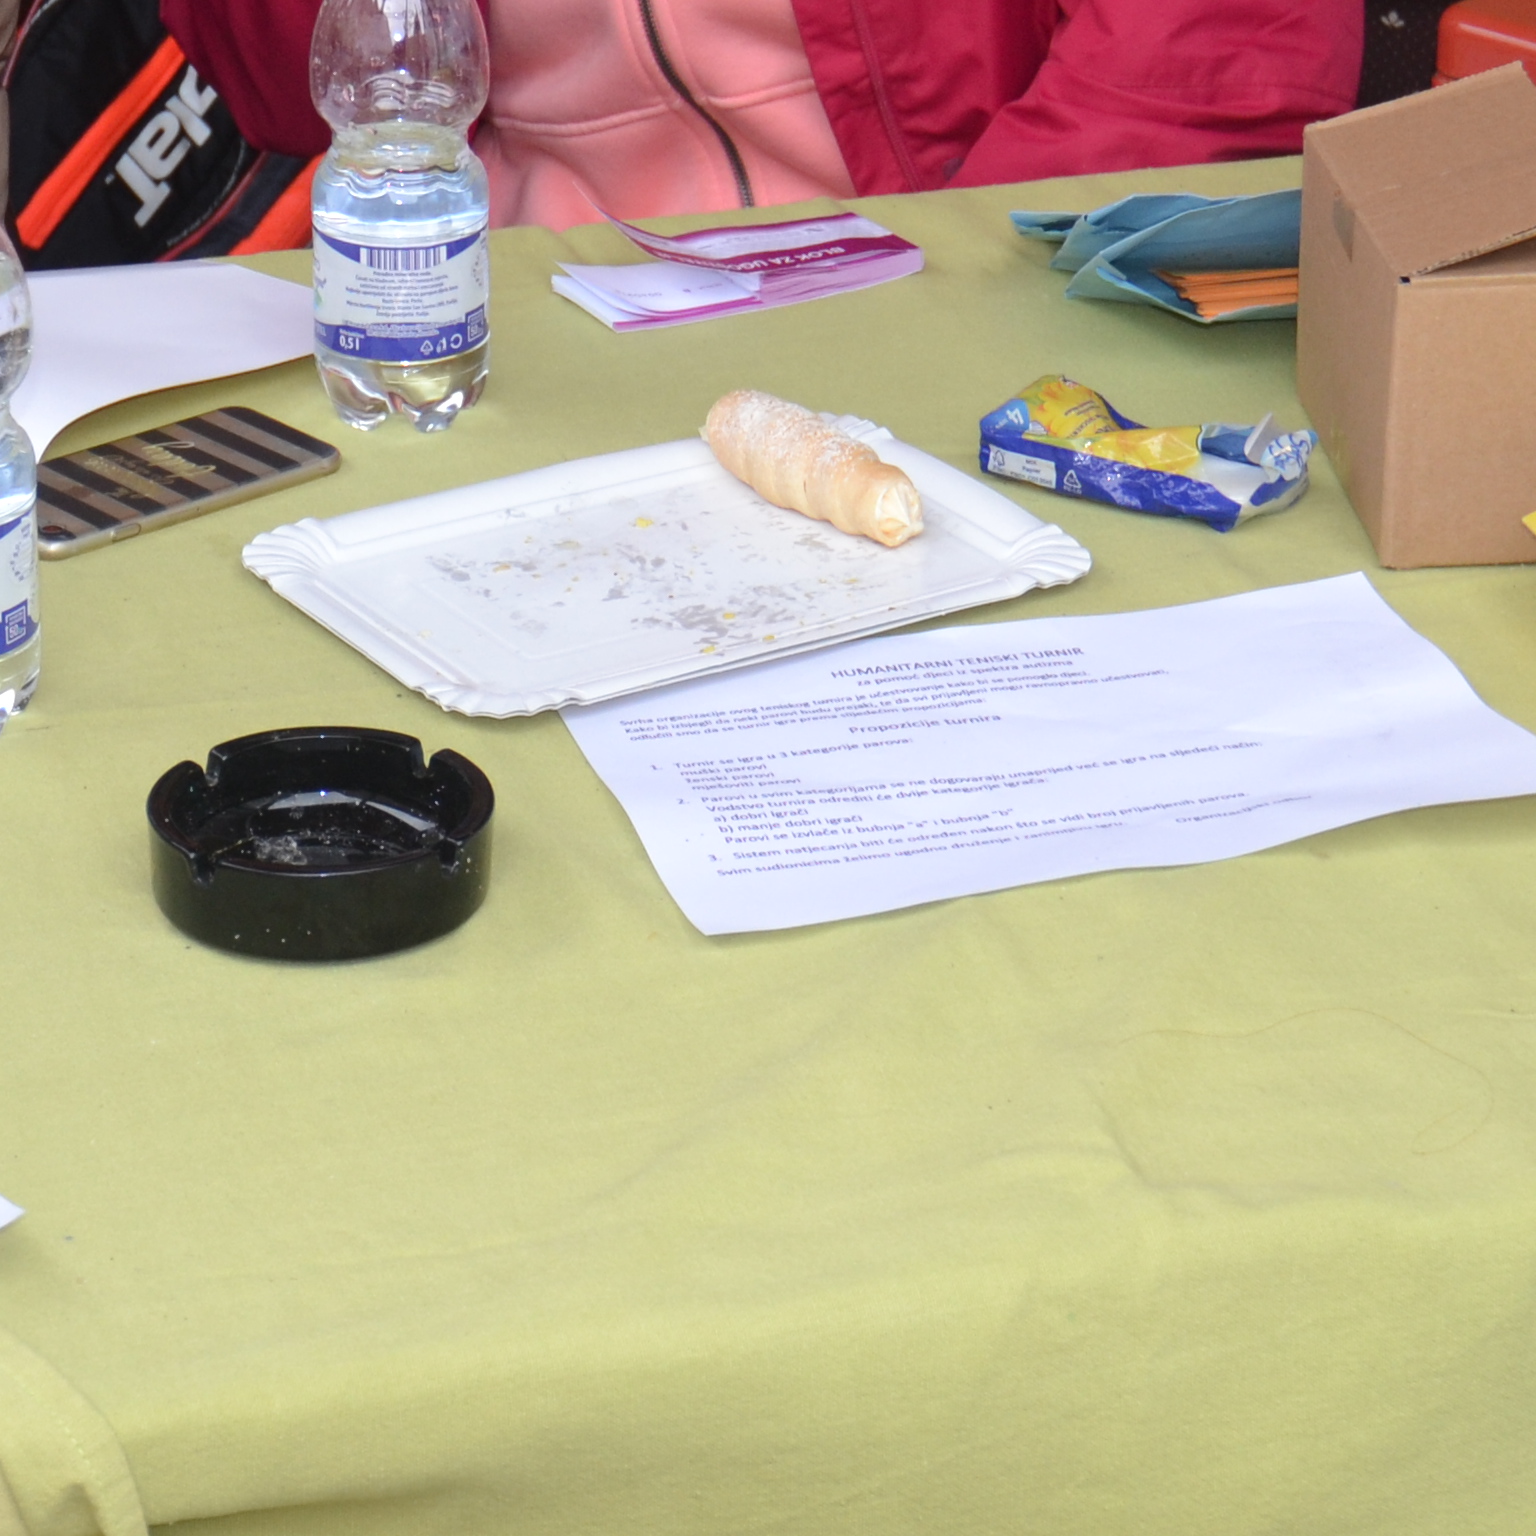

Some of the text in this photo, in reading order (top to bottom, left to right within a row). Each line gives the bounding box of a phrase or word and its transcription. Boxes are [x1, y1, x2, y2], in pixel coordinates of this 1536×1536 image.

[768, 254, 795, 266] ZA
[795, 246, 846, 261] BLOK
[830, 647, 1084, 678] HUMANITARNI TENISKI TURNIR
[873, 673, 920, 685] pomoć
[922, 670, 953, 678] djeci
[969, 665, 1019, 674] spektra
[1022, 660, 1073, 669] autizma
[848, 715, 1001, 733] Propozicije turnira
[673, 760, 714, 768] Turnir
[736, 755, 763, 763] igra
[790, 743, 858, 756] kategorije
[705, 802, 764, 812] Vodstvo
[766, 798, 816, 807] turnira
[818, 794, 873, 803] odrediti
[895, 789, 928, 798] dvije
[930, 783, 1000, 794] kategorije
[730, 811, 767, 820] dobri
[769, 808, 808, 818] igrači
[737, 821, 780, 831] manje
[784, 818, 822, 827] dobri
[824, 815, 862, 825] igrači
[724, 834, 770, 844] Parovi
[791, 827, 838, 838] izvlače
[855, 823, 904, 832] bubnja
[940, 813, 990, 824] bubnja
